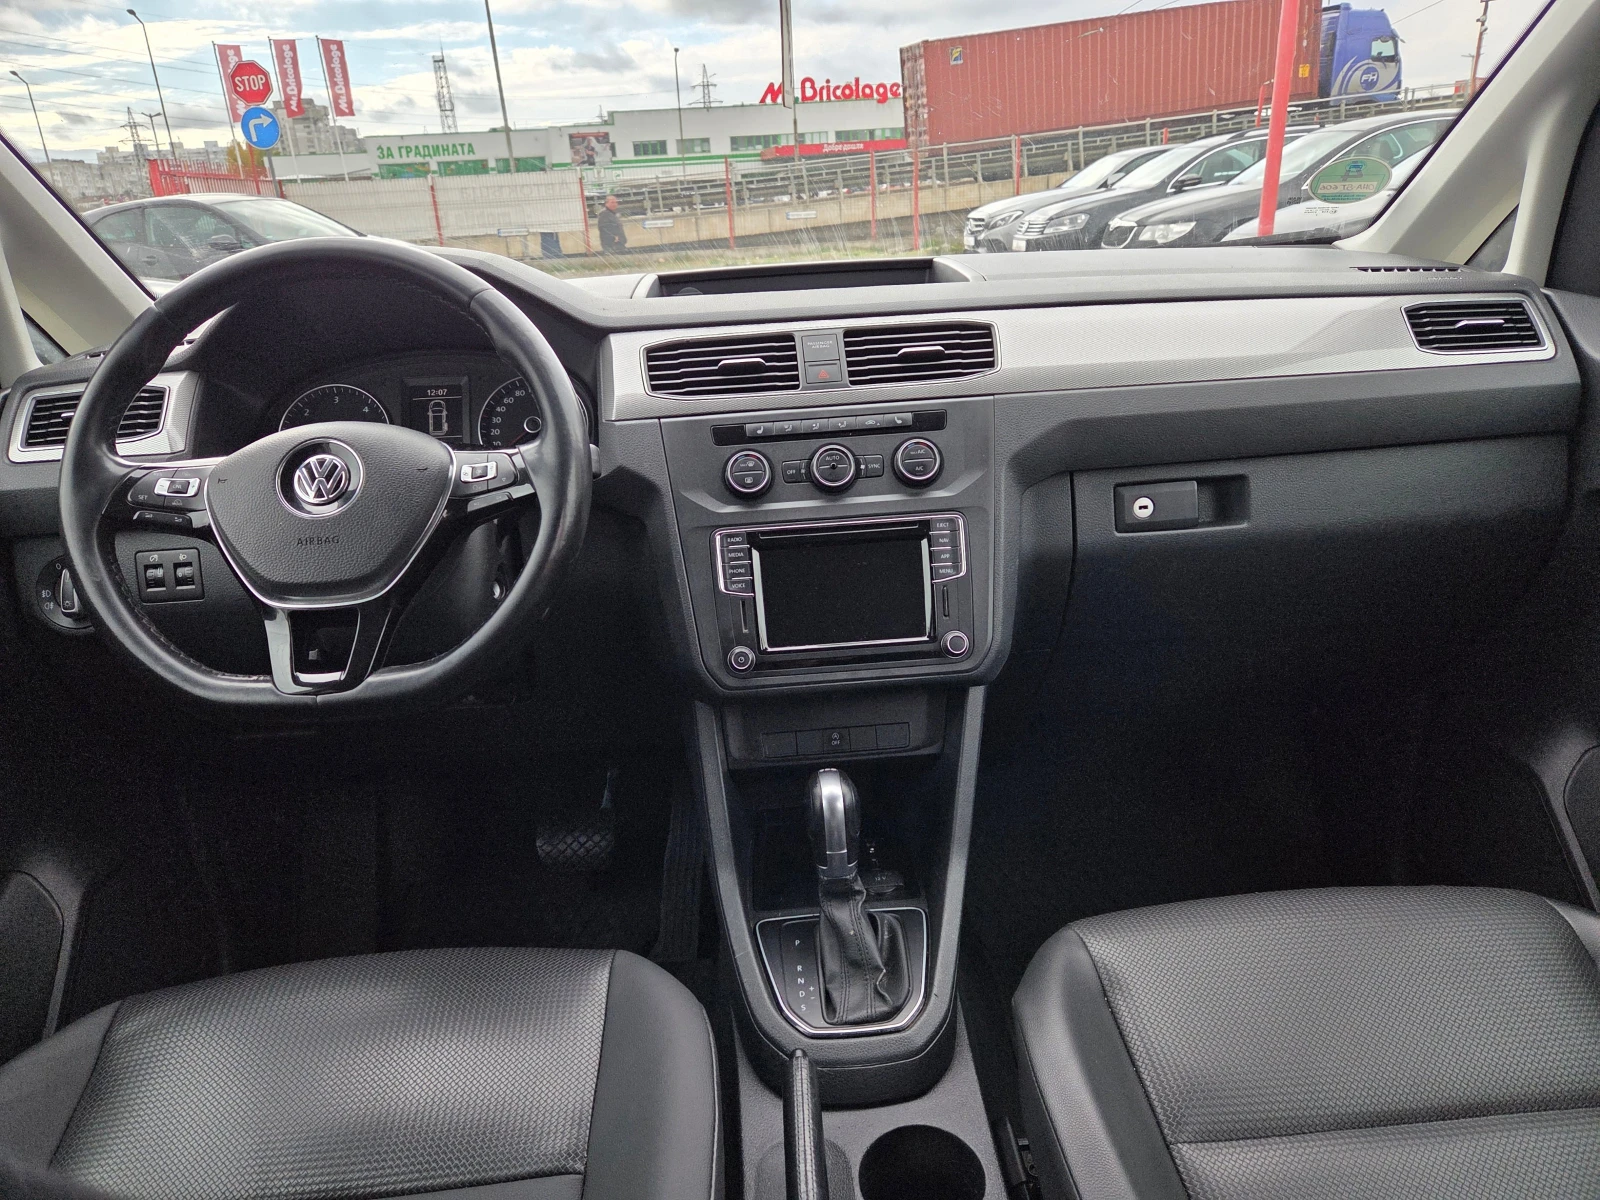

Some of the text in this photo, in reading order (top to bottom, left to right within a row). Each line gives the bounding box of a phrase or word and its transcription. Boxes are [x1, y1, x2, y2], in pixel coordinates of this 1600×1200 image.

[329, 44, 349, 113] Mr.Bricolage
[1361, 71, 1378, 83] FH
[234, 74, 266, 92] STOP
[376, 142, 476, 160] ЗА ГРАДИНАТА
[427, 388, 448, 396] 12:07
[333, 396, 339, 404] 3
[503, 396, 514, 404] 60
[304, 408, 310, 416] 2
[495, 405, 506, 413] 40
[491, 416, 502, 424] 30
[825, 454, 840, 462] AUTO
[296, 534, 340, 546] AIRBAG
[799, 990, 805, 998] D
[801, 1004, 807, 1012] S
